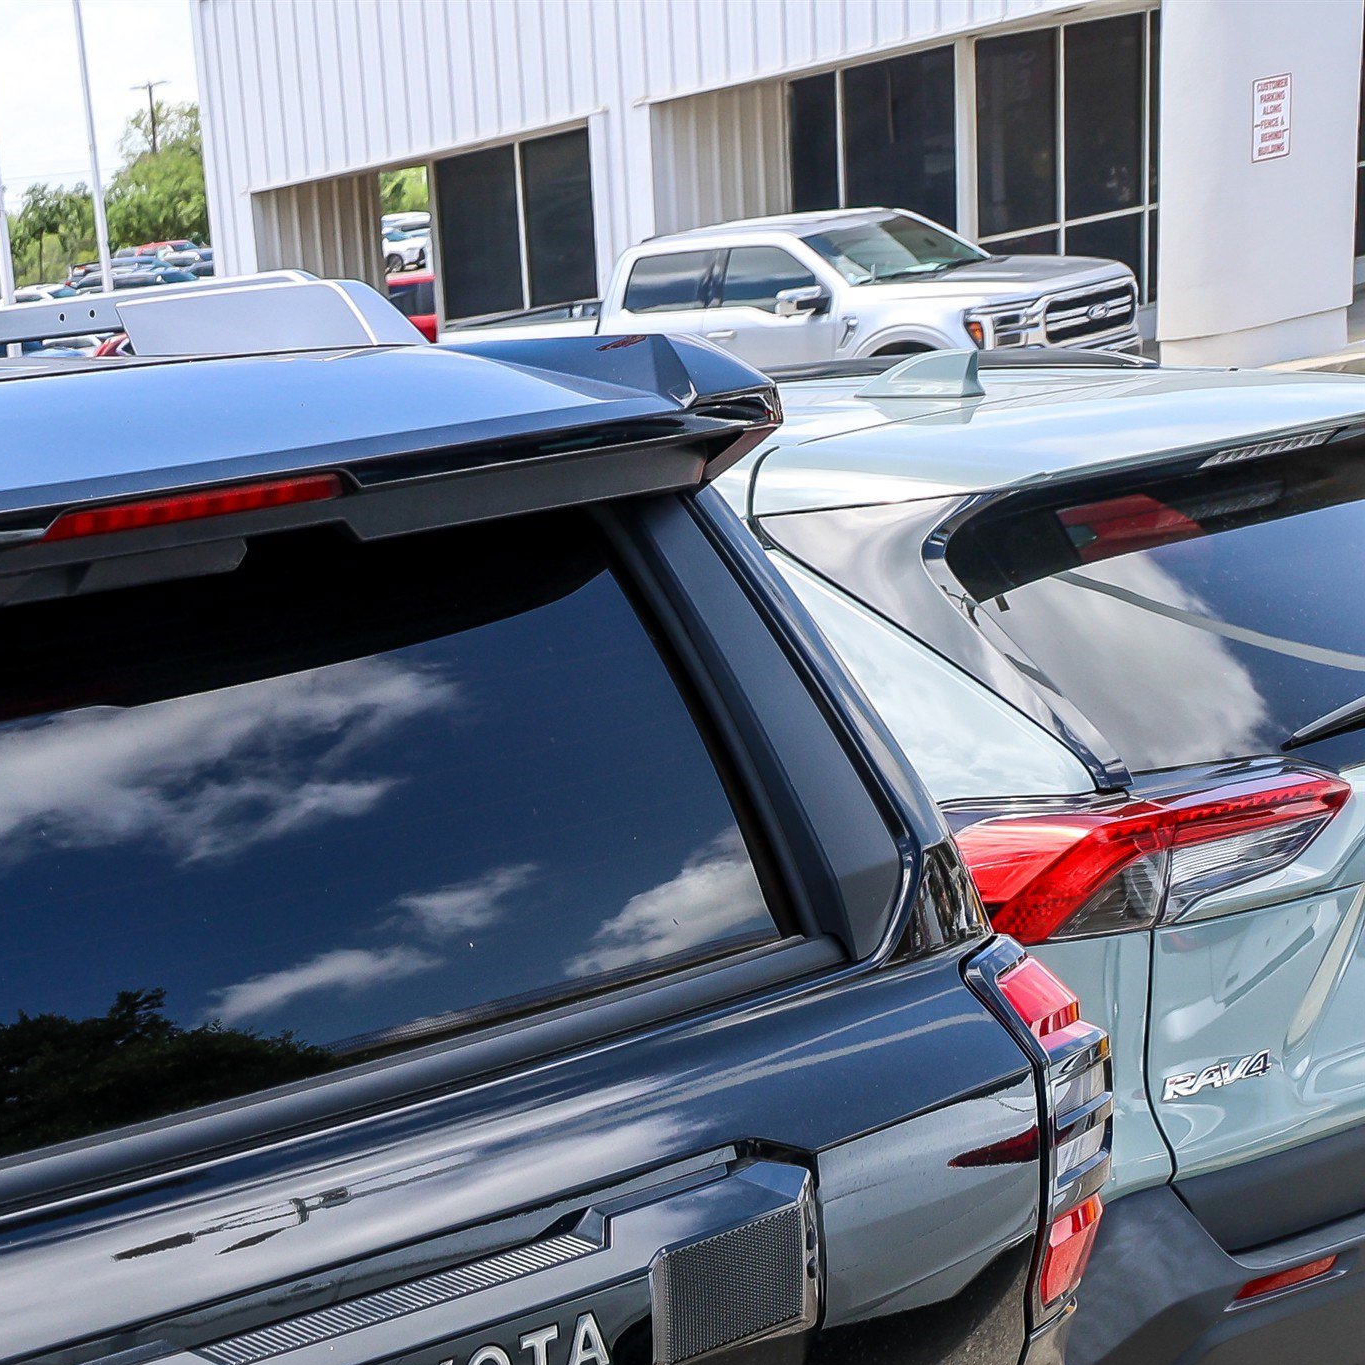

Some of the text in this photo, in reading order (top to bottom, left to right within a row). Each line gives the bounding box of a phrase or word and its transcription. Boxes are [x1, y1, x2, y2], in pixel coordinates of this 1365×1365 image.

[1257, 77, 1288, 92] CUSTOMER
[1260, 90, 1285, 104] PARKING
[1262, 103, 1282, 116] ALONG
[1260, 116, 1279, 129] FENCE
[1261, 129, 1282, 143] BEHIND
[1258, 142, 1285, 156] BUILDING
[1160, 1047, 1273, 1102] RAV4
